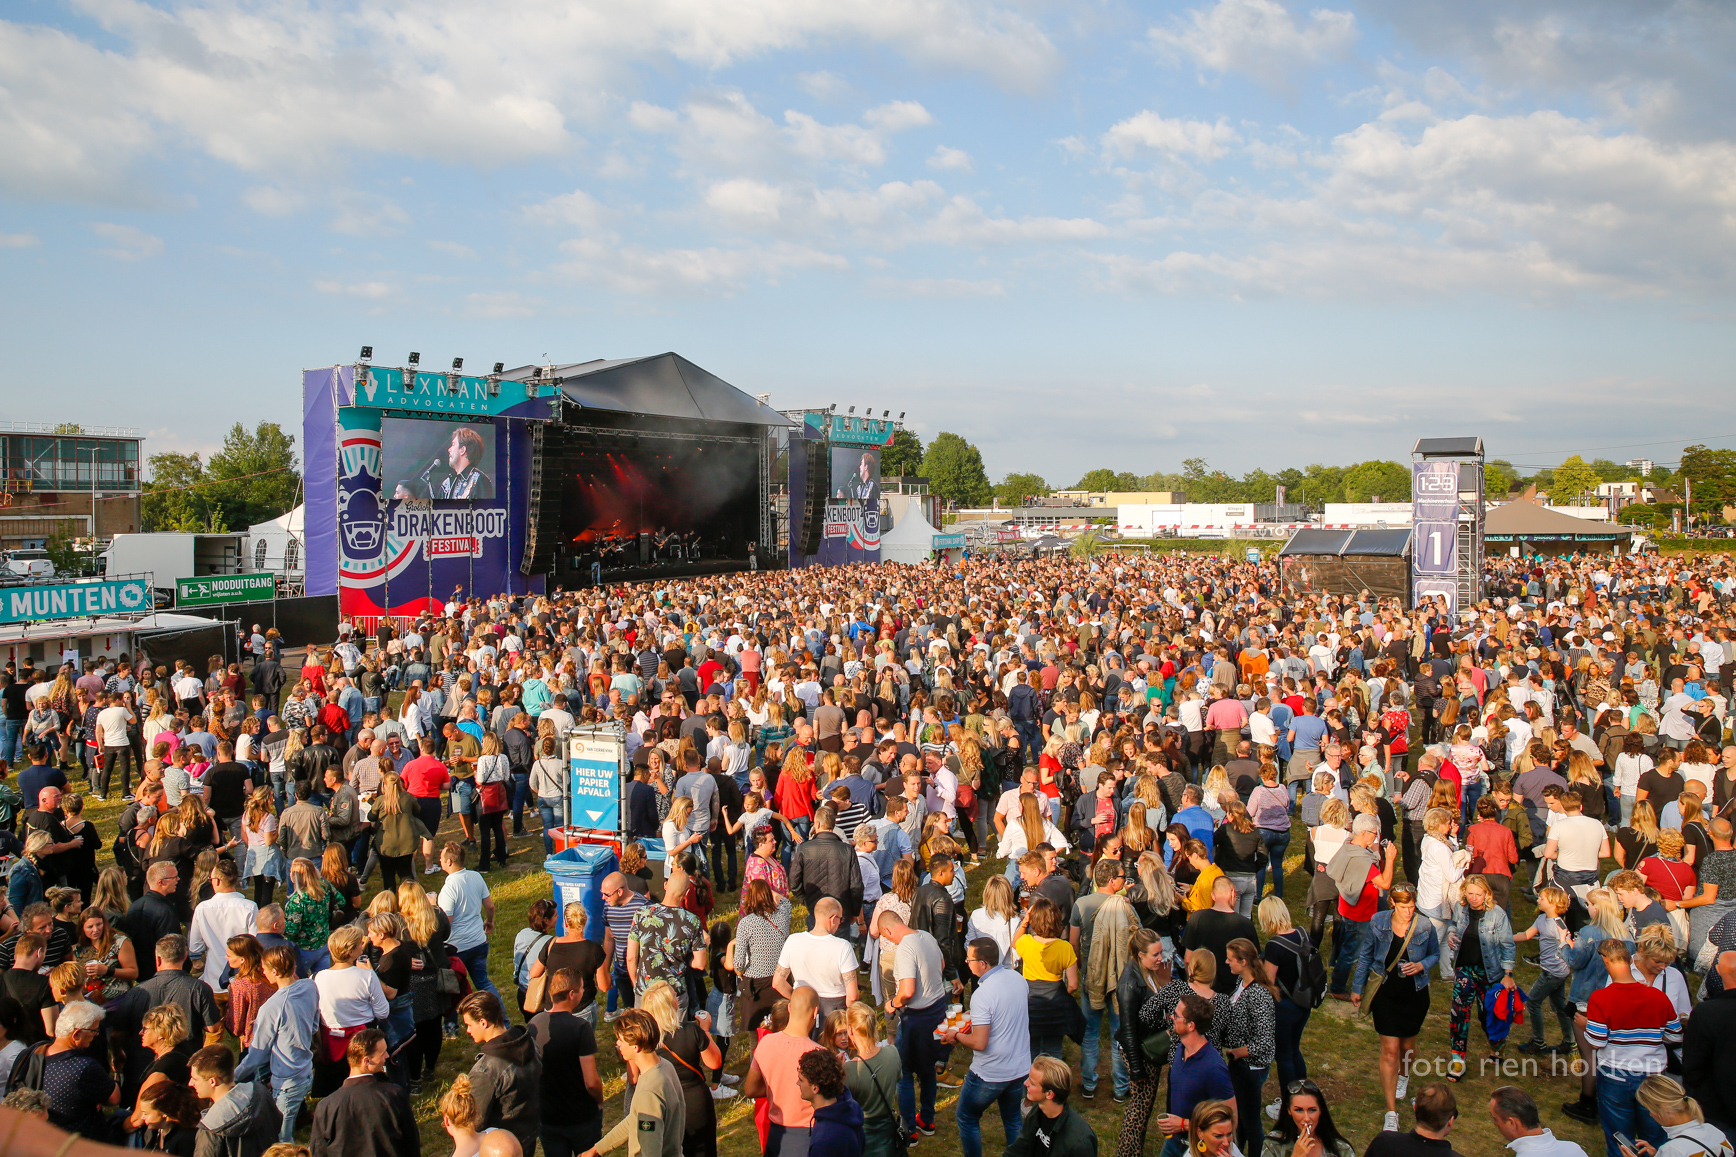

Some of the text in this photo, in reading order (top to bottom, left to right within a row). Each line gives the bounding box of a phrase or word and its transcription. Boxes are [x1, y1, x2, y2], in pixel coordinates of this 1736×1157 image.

[387, 396, 488, 411] ADVOCATEN
[836, 419, 879, 435] LXMN
[836, 433, 879, 441] ADVOCATEN
[397, 512, 504, 537] DRAKENBOOT
[1428, 531, 1442, 566] 1
[211, 577, 273, 591] NOODUITGANG
[11, 586, 117, 617] MUNTEN
[575, 767, 613, 779] HIER UW
[579, 776, 610, 788] PAPIER
[577, 786, 605, 797] AFVAL
